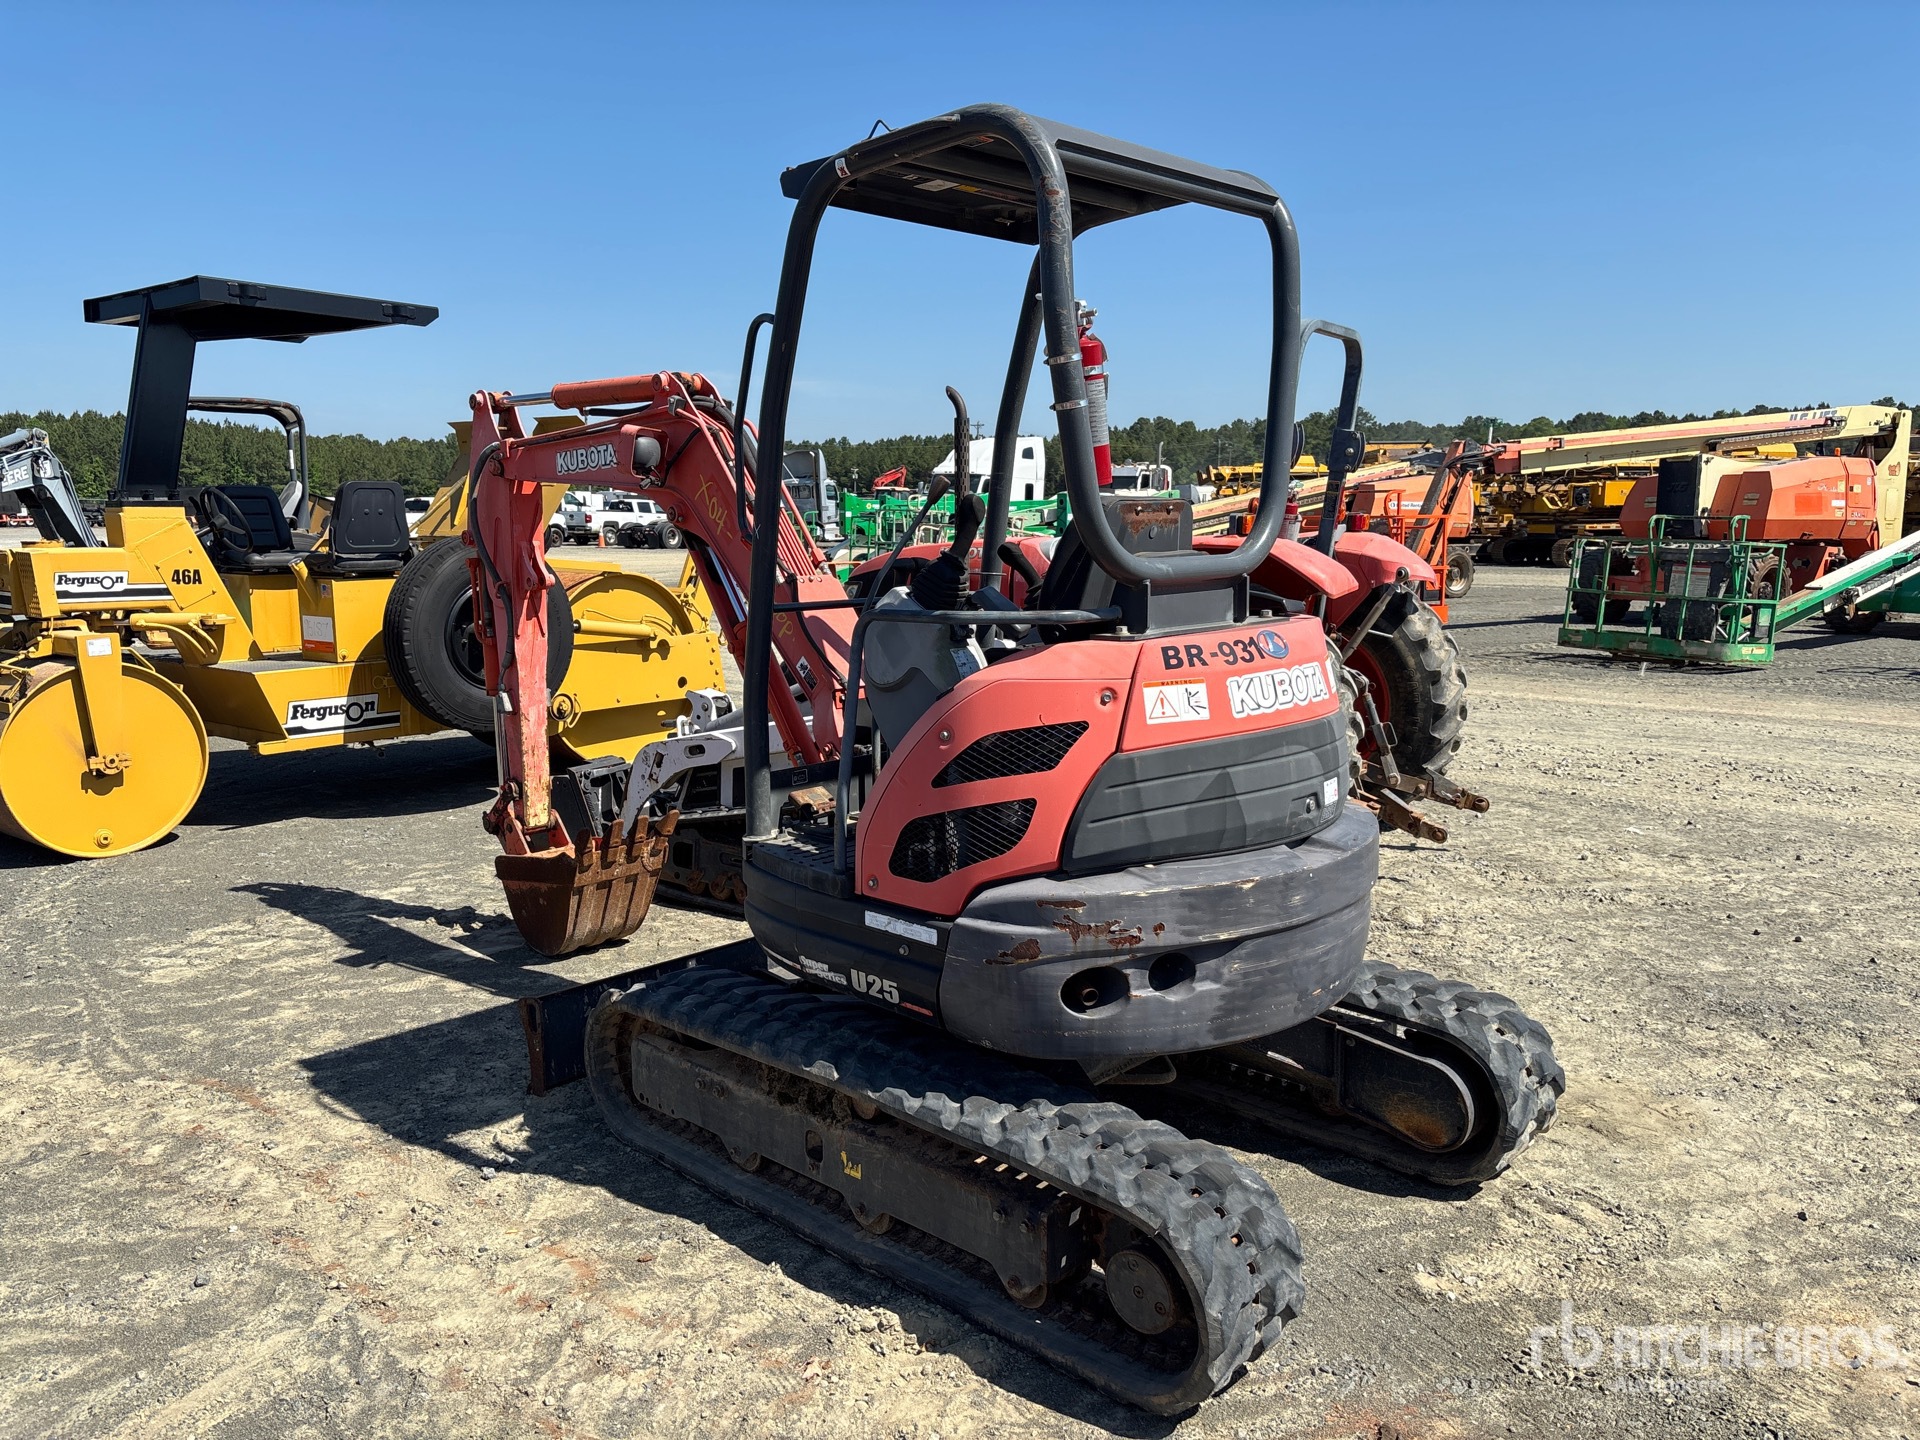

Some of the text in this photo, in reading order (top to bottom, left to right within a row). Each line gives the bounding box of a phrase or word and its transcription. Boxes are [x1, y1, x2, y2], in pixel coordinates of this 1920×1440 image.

[556, 442, 618, 475] KUBOTA
[2, 466, 30, 486] EERE
[56, 574, 124, 590] Ferguson
[171, 568, 202, 585] 46A
[1161, 636, 1266, 670] BR-931
[1160, 678, 1194, 687] WARNING
[1228, 663, 1328, 716] KUBOTA
[290, 700, 376, 722] Ferguson
[850, 968, 900, 1004] U25
